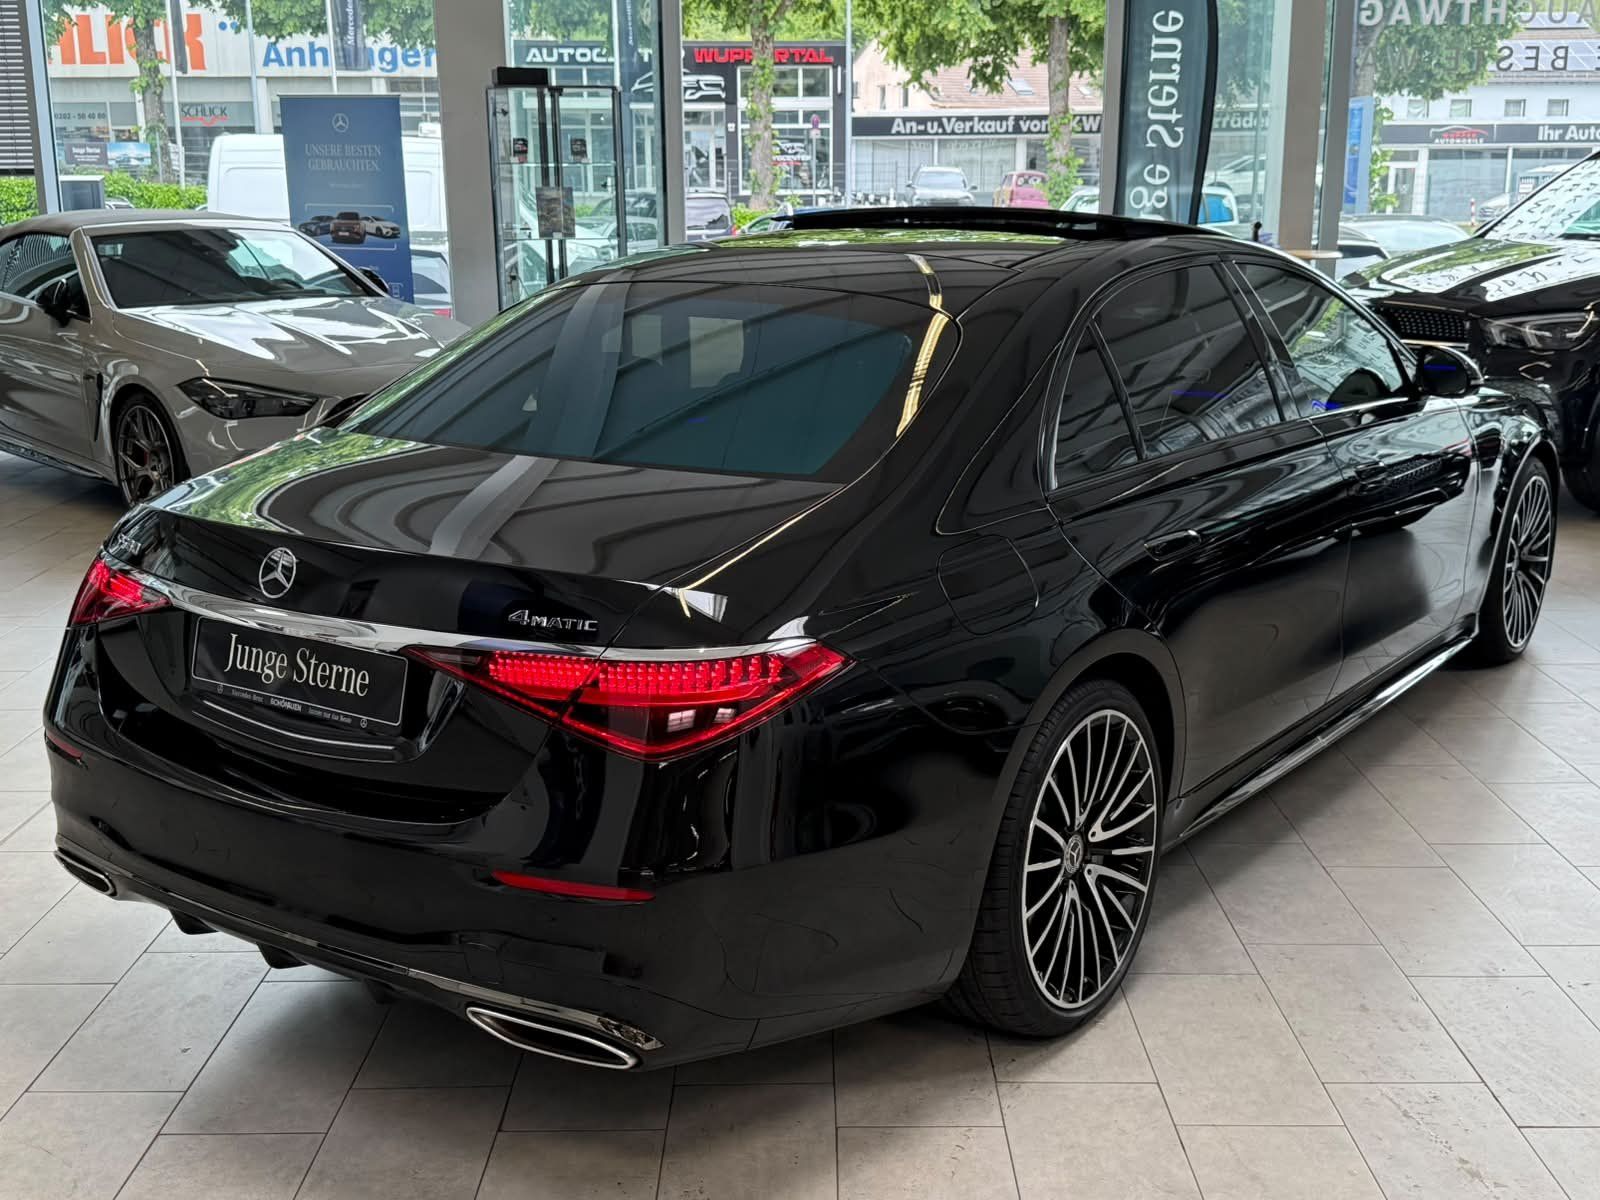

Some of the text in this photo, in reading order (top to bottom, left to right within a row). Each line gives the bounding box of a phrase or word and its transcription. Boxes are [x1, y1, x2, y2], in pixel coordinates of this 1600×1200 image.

[262, 42, 436, 72] Anhger
[693, 47, 834, 63] WUPPRTAL
[180, 105, 228, 117] SCHLICK
[1065, 115, 1100, 132] KW
[1537, 125, 1563, 141] Ihr
[305, 144, 381, 157] UNSERE BESTEN
[508, 610, 598, 631] 4MATIC
[224, 633, 370, 697] Junge Sterne
